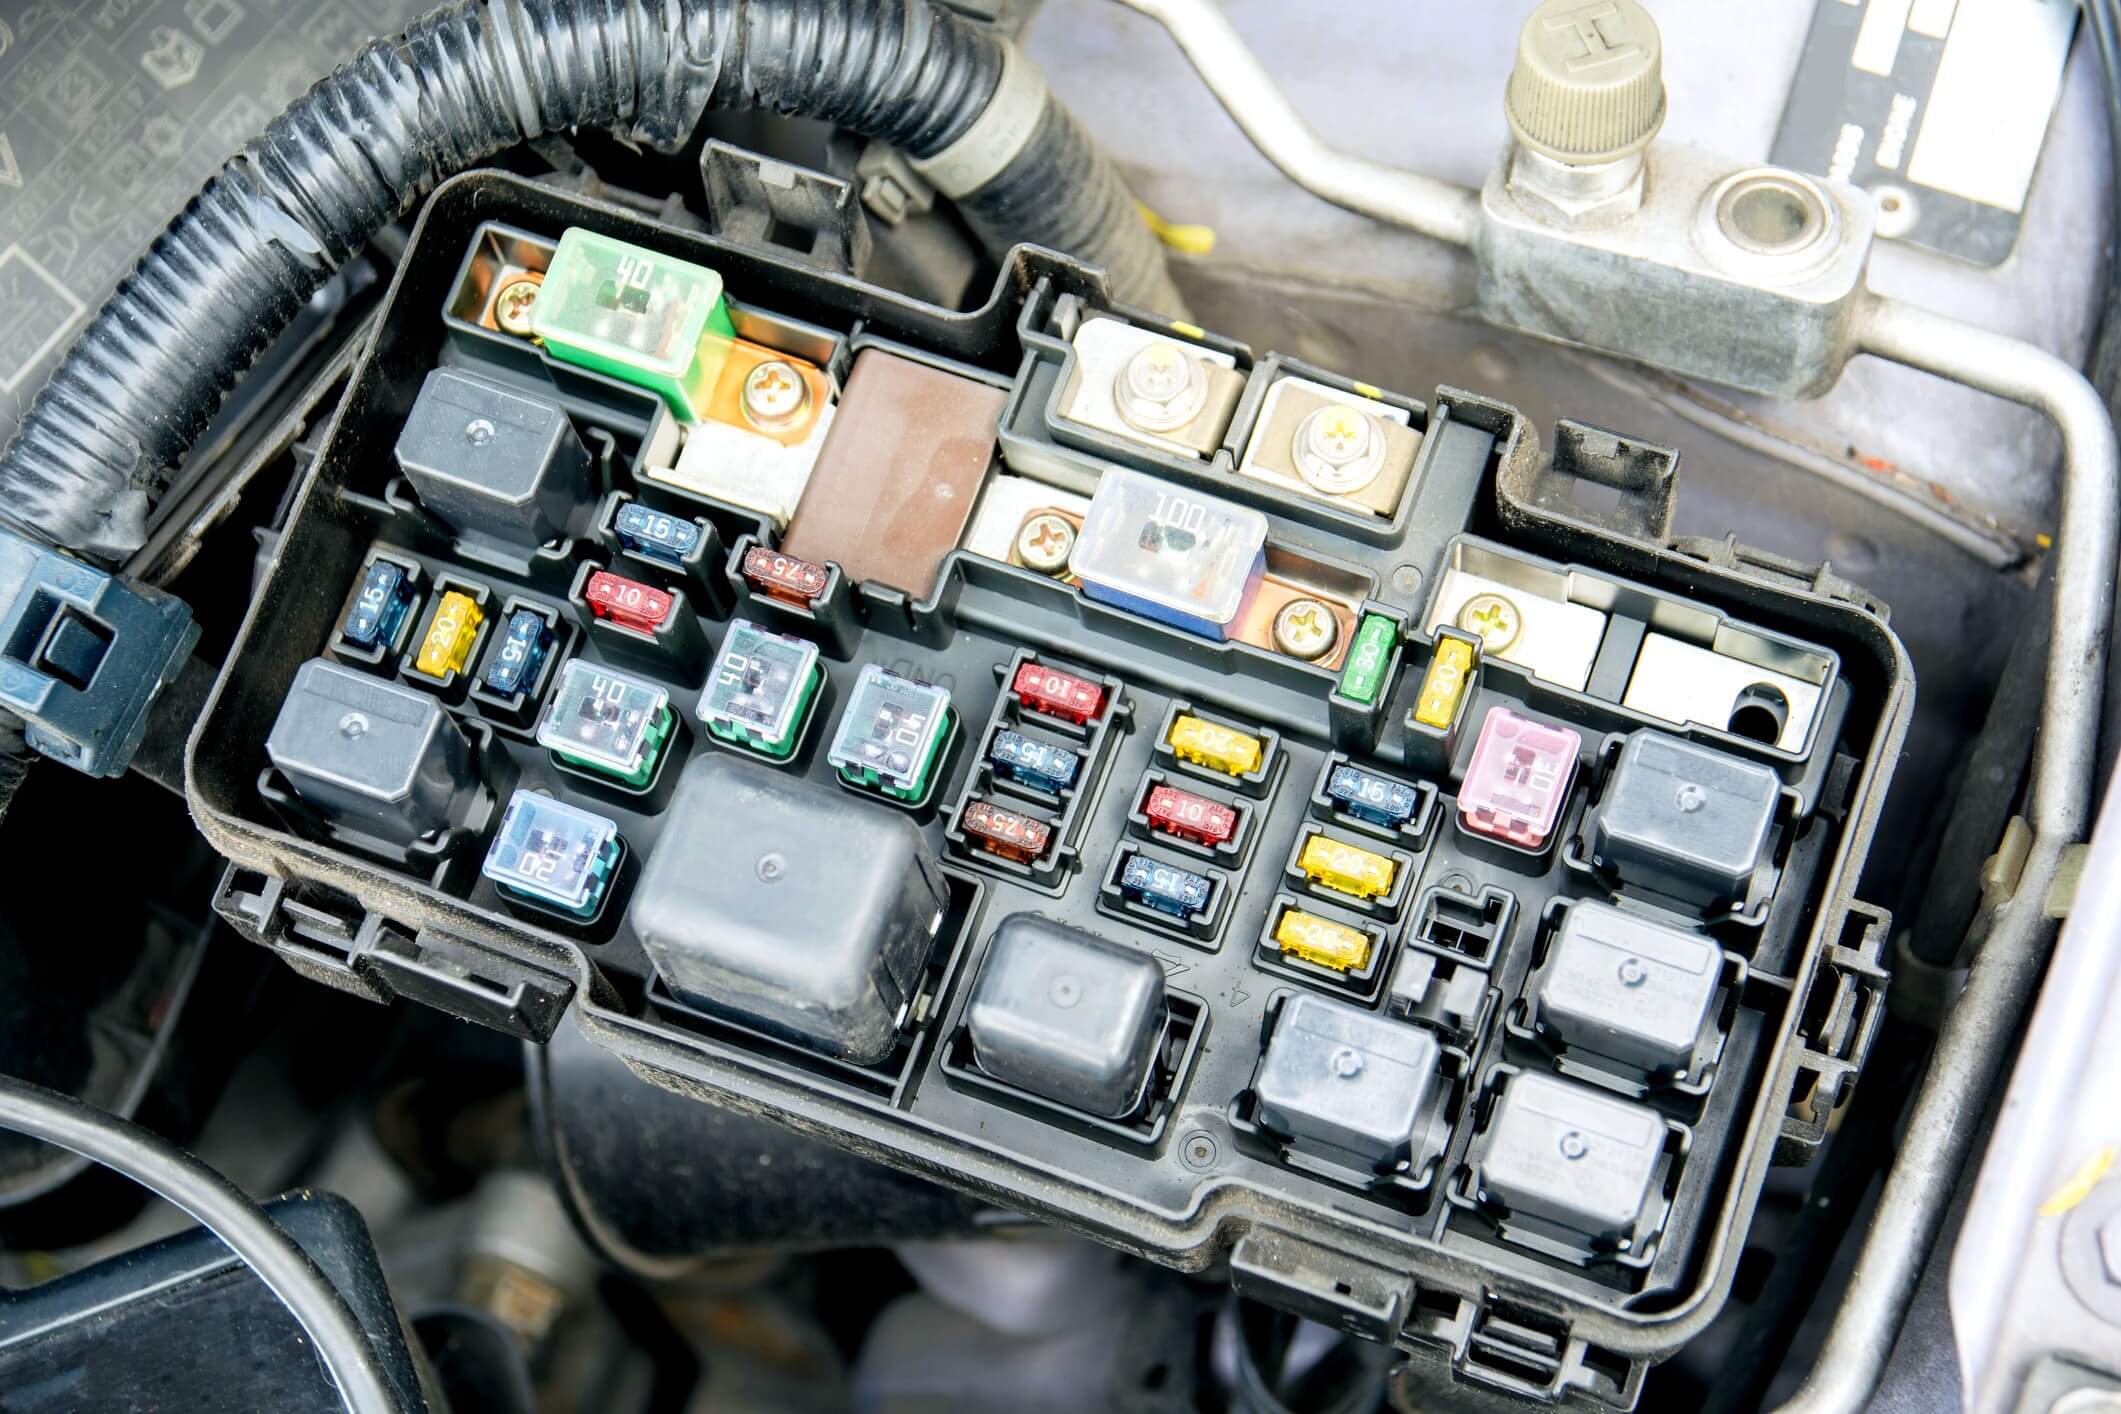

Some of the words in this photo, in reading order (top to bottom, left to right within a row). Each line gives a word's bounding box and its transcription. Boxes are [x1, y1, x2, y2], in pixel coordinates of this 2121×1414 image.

[616, 255, 654, 289] 40
[1148, 492, 1206, 531] 100
[642, 514, 671, 538] 15
[773, 557, 802, 580] 7.5
[359, 587, 385, 613] 15
[614, 584, 641, 608] 10
[431, 617, 457, 647] 20
[501, 634, 527, 662] 15
[717, 653, 747, 686] 40
[1432, 663, 1458, 694] 20
[591, 676, 626, 703] 40
[1045, 676, 1070, 696] 10
[894, 712, 927, 747] 40
[1200, 728, 1233, 751] 20
[1021, 742, 1048, 765] 15
[1528, 759, 1562, 792] 30
[1358, 778, 1384, 801] 15
[1175, 799, 1202, 820] 10
[518, 853, 557, 882] 20
[1333, 848, 1363, 875] 20
[1152, 868, 1180, 892] 15
[1307, 925, 1337, 950] 20
